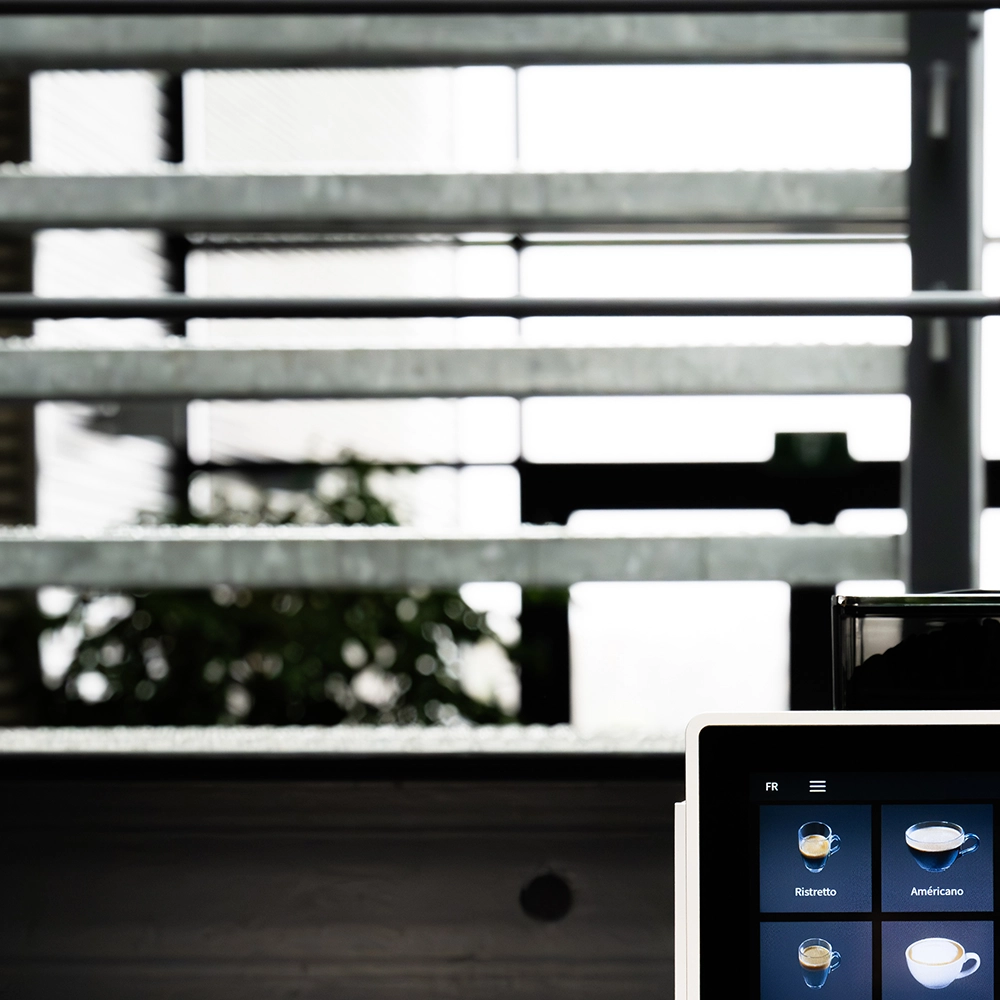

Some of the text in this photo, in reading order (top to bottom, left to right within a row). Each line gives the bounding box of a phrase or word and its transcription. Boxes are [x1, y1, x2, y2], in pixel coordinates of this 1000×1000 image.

[765, 781, 779, 792] FR
[794, 886, 837, 897] Ristretto
[911, 884, 964, 896] Américano
